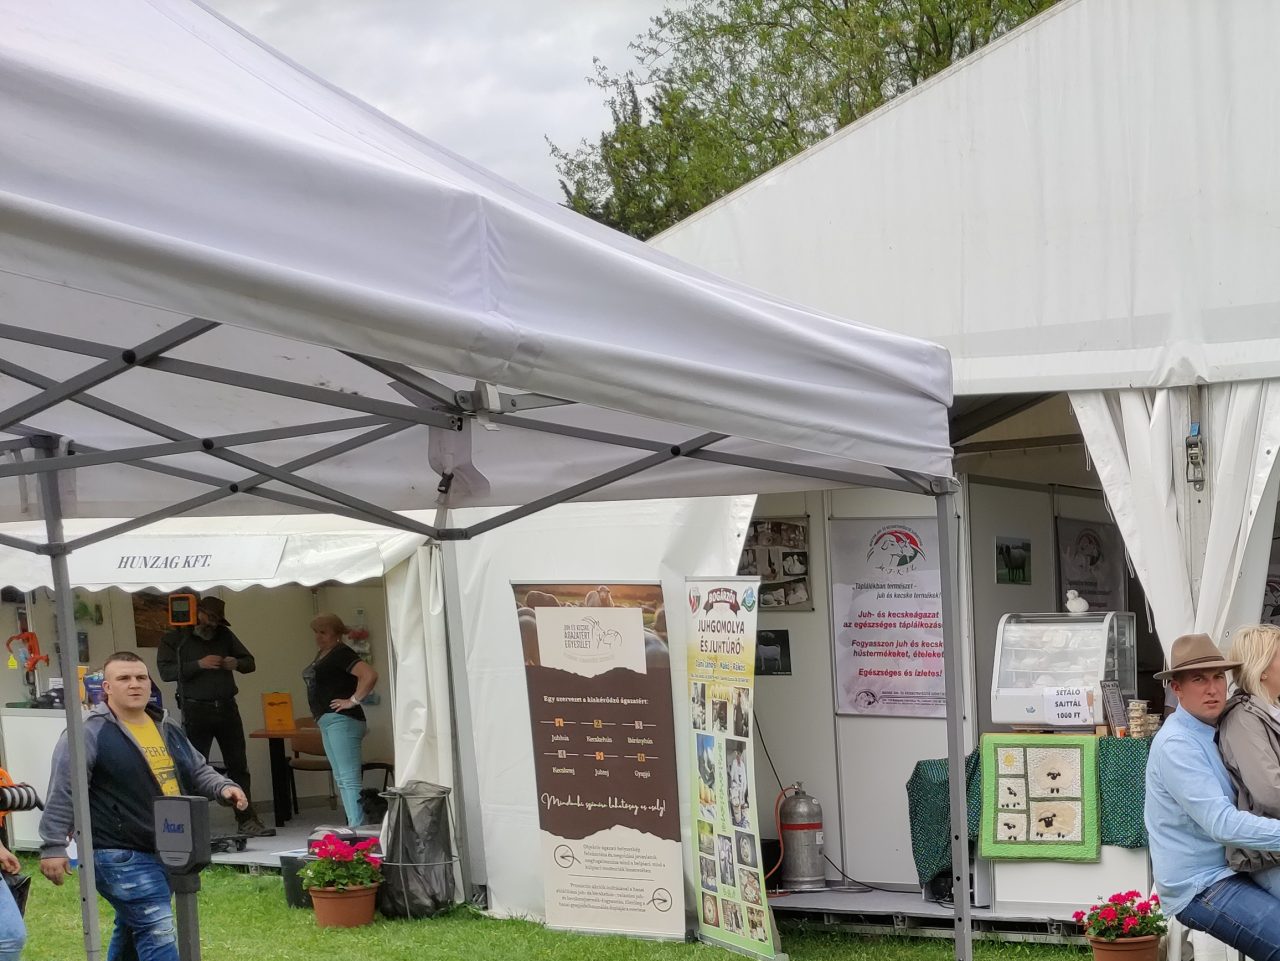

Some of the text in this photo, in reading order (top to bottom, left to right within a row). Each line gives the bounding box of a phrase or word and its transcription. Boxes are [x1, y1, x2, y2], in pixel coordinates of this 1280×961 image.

[117, 554, 212, 569] HUNZAG KFT.
[887, 611, 939, 620] kecskeágazat
[698, 619, 745, 634] JUHGOMOLYA
[854, 621, 897, 630] egészséges
[899, 621, 943, 630] táplálkozás
[700, 636, 708, 653] ÉS
[851, 640, 943, 649] Fogyasszon juh és kecsk
[858, 668, 901, 677] Egészséges
[915, 669, 942, 677] ízletes!
